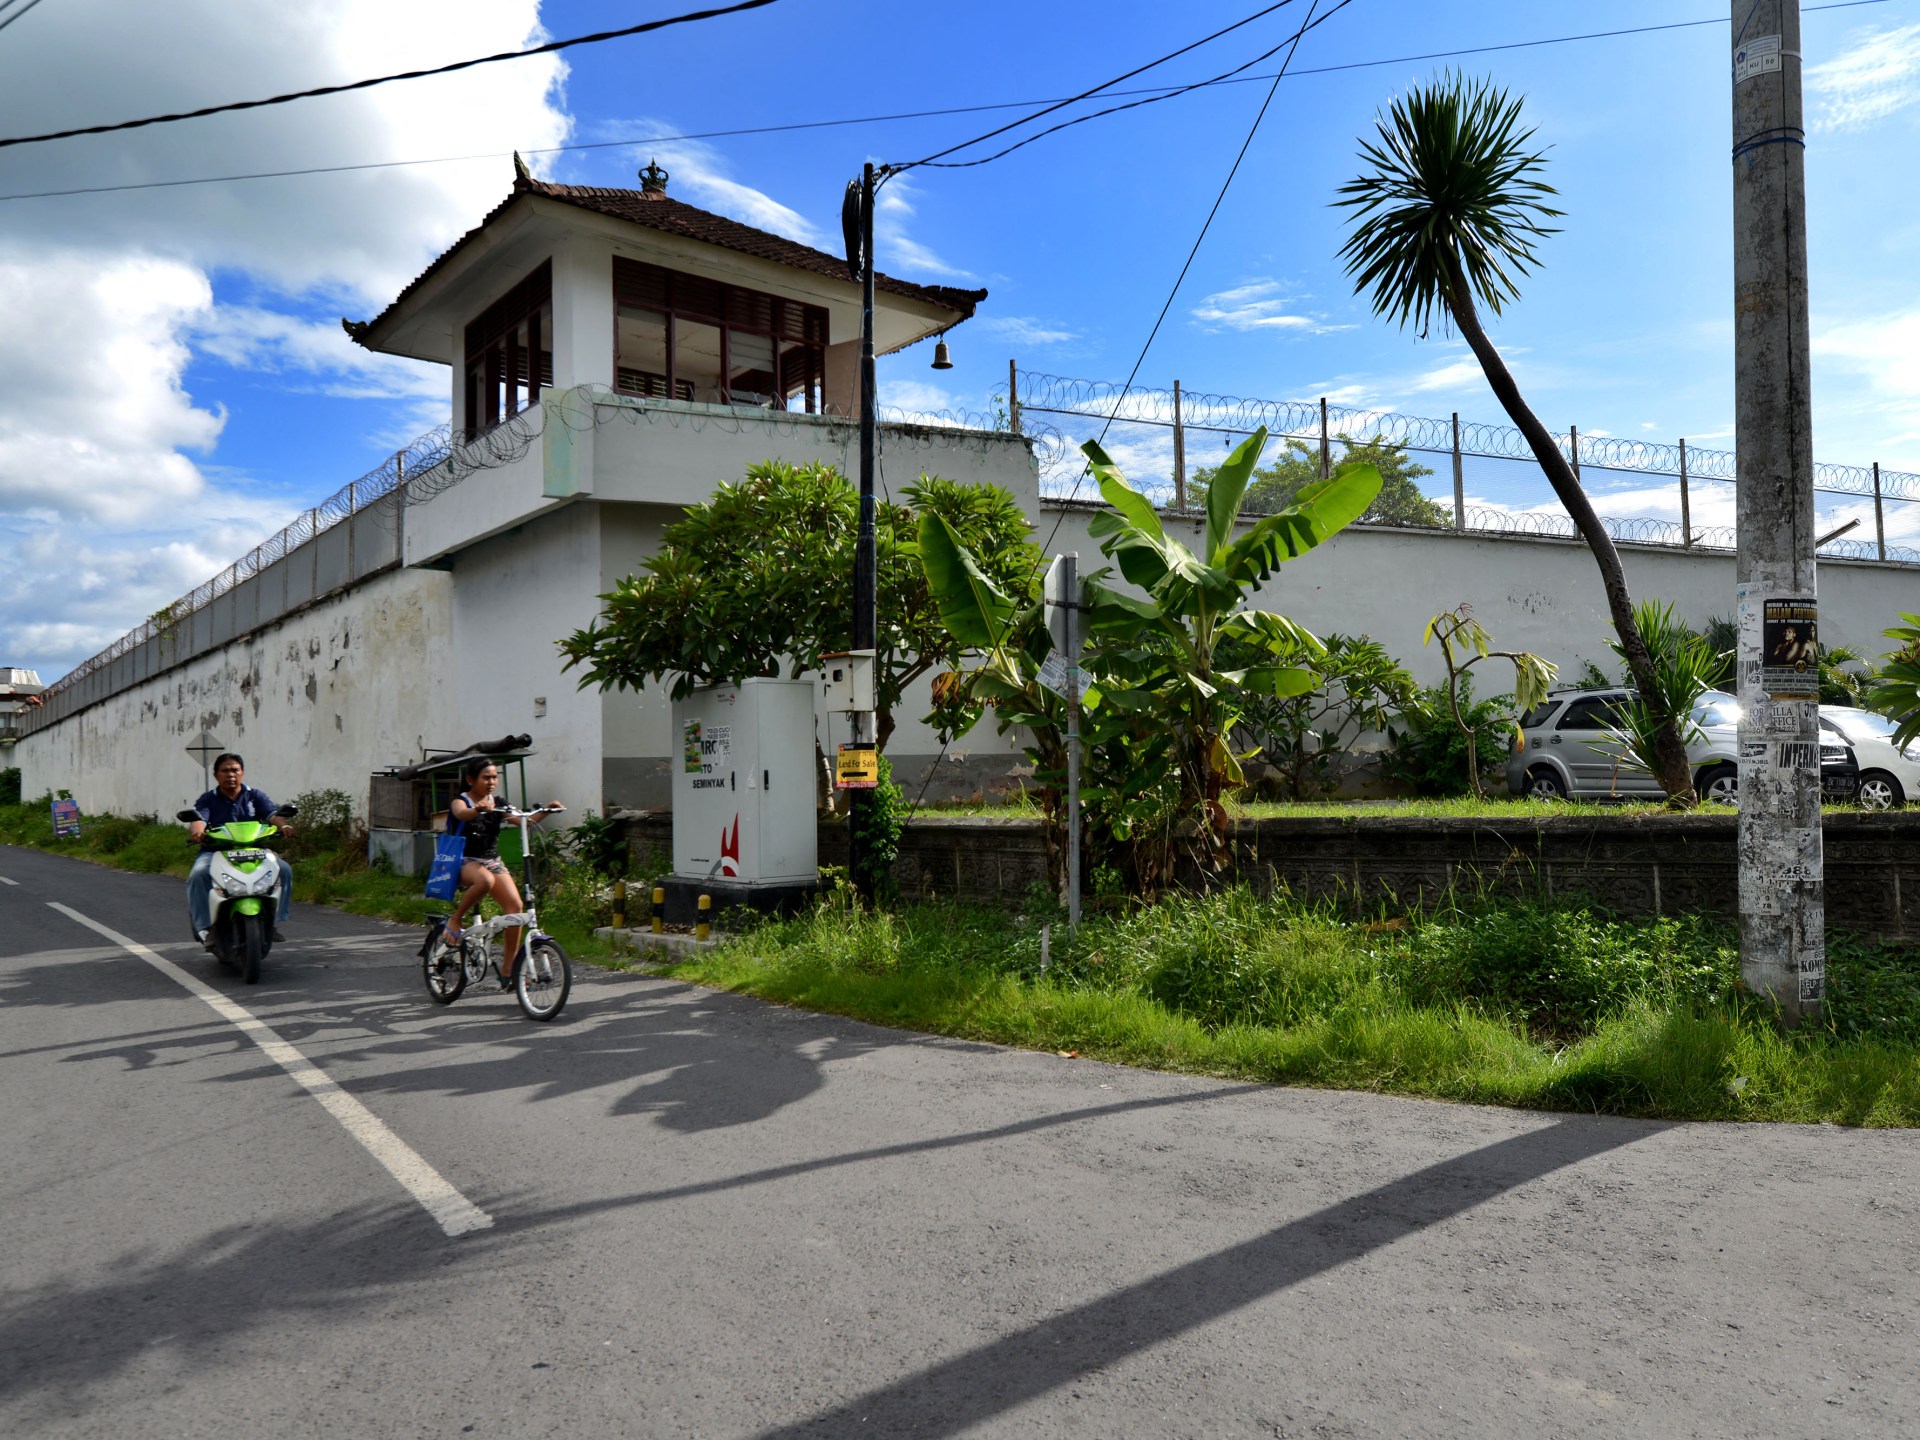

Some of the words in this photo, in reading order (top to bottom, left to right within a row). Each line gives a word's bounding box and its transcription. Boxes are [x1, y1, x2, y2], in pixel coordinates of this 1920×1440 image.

[1767, 608, 1791, 618] MALAM
[1770, 706, 1793, 717] ILLA
[1771, 716, 1797, 726] FFICE
[1779, 743, 1819, 769] INTERNE
[839, 760, 851, 768] Land
[852, 760, 860, 768] For
[863, 760, 876, 768] Sale
[693, 779, 725, 789] SEMINYAK
